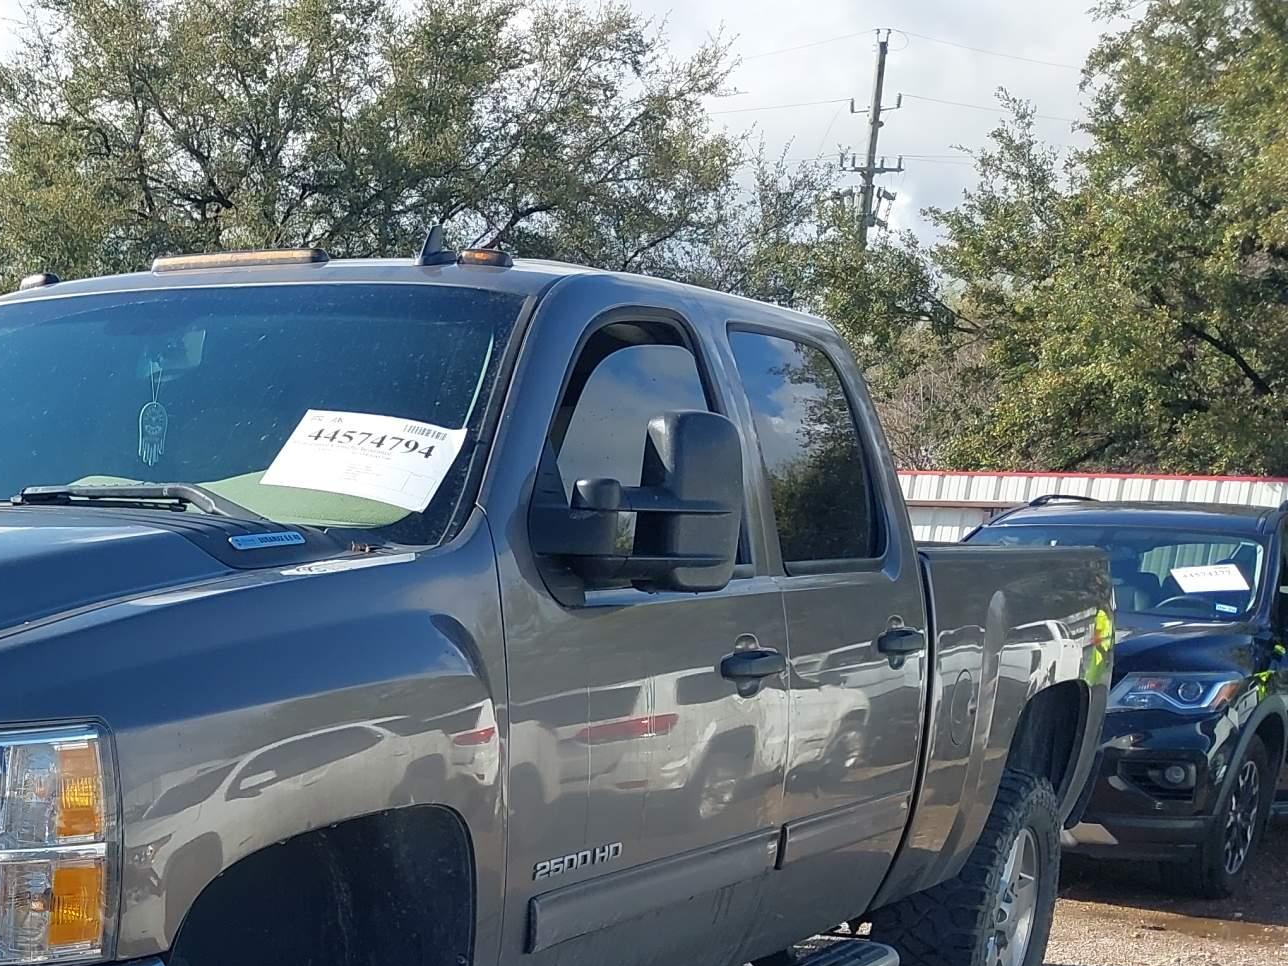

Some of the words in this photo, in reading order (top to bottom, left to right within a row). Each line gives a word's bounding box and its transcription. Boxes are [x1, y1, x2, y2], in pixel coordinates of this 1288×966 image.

[308, 428, 435, 459] 44574794
[532, 850, 592, 881] 2500
[592, 842, 623, 865] HD
